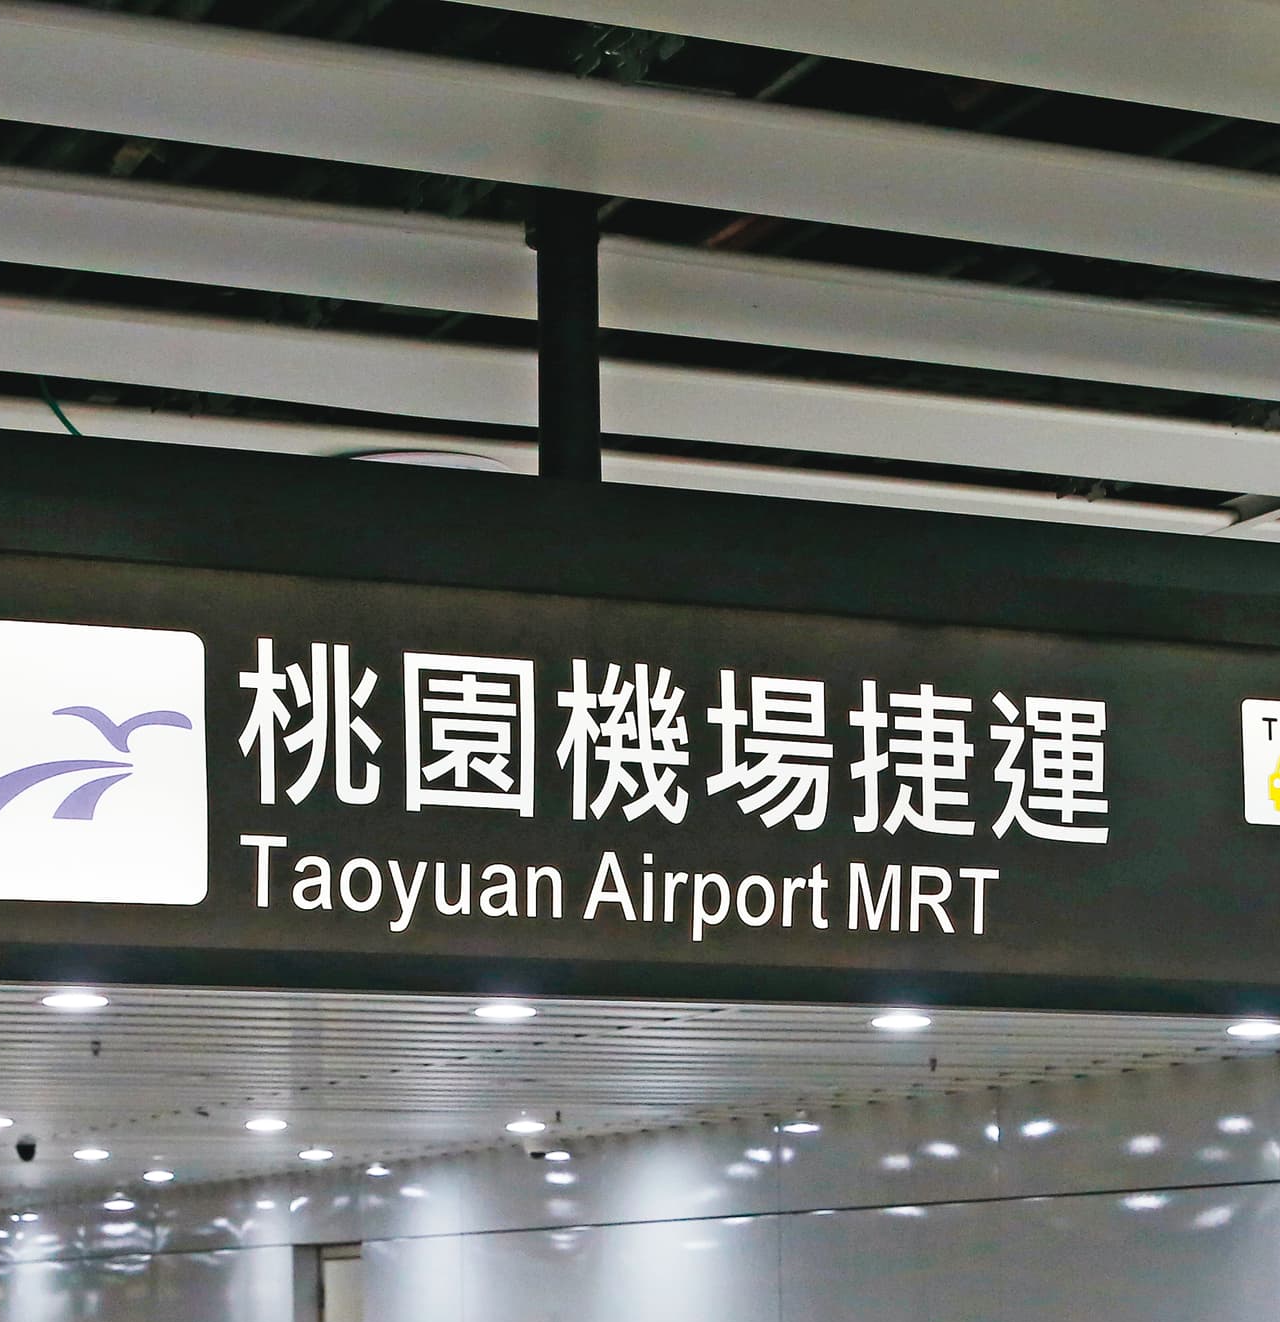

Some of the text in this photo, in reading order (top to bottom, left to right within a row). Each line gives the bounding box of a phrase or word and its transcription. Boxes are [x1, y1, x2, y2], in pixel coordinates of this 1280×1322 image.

[239, 638, 1109, 844] 桃園機場捷運
[239, 834, 1000, 942] Taoyuan Airport MRT
